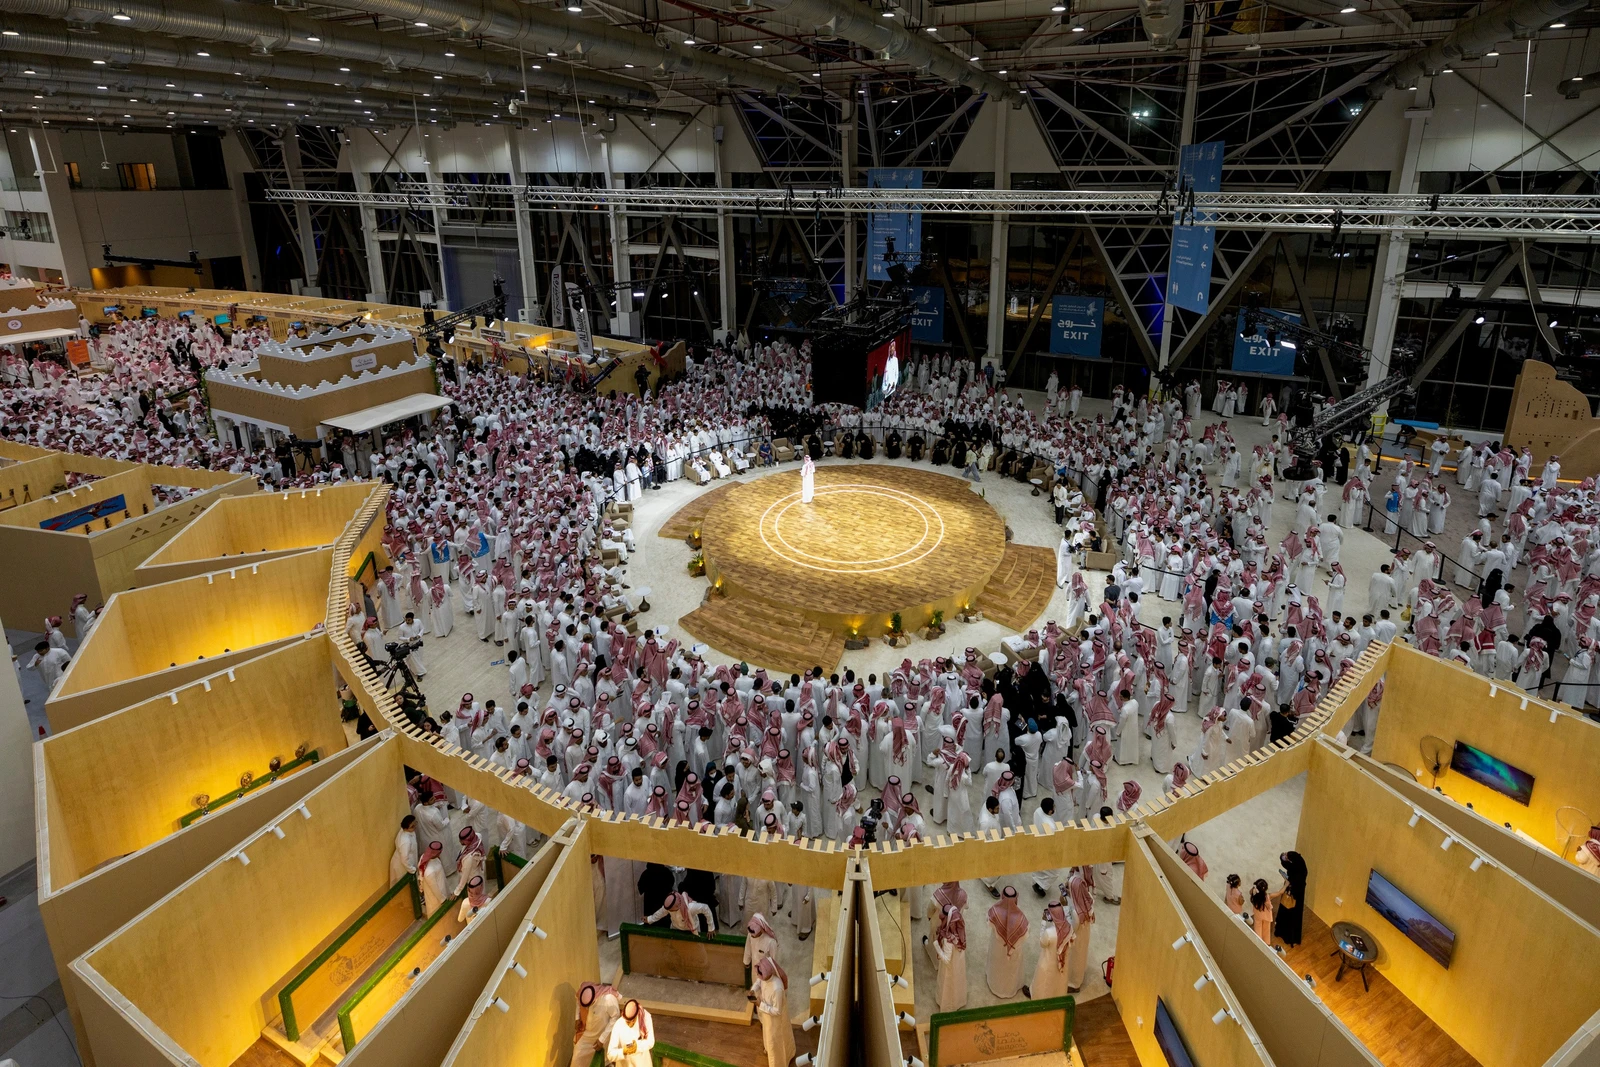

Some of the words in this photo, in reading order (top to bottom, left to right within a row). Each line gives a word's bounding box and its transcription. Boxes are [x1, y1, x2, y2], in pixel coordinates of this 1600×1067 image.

[911, 318, 933, 327] EXIT
[1058, 319, 1096, 328] خروج
[1063, 331, 1089, 340] EXIT
[1249, 346, 1281, 357] EXIT
